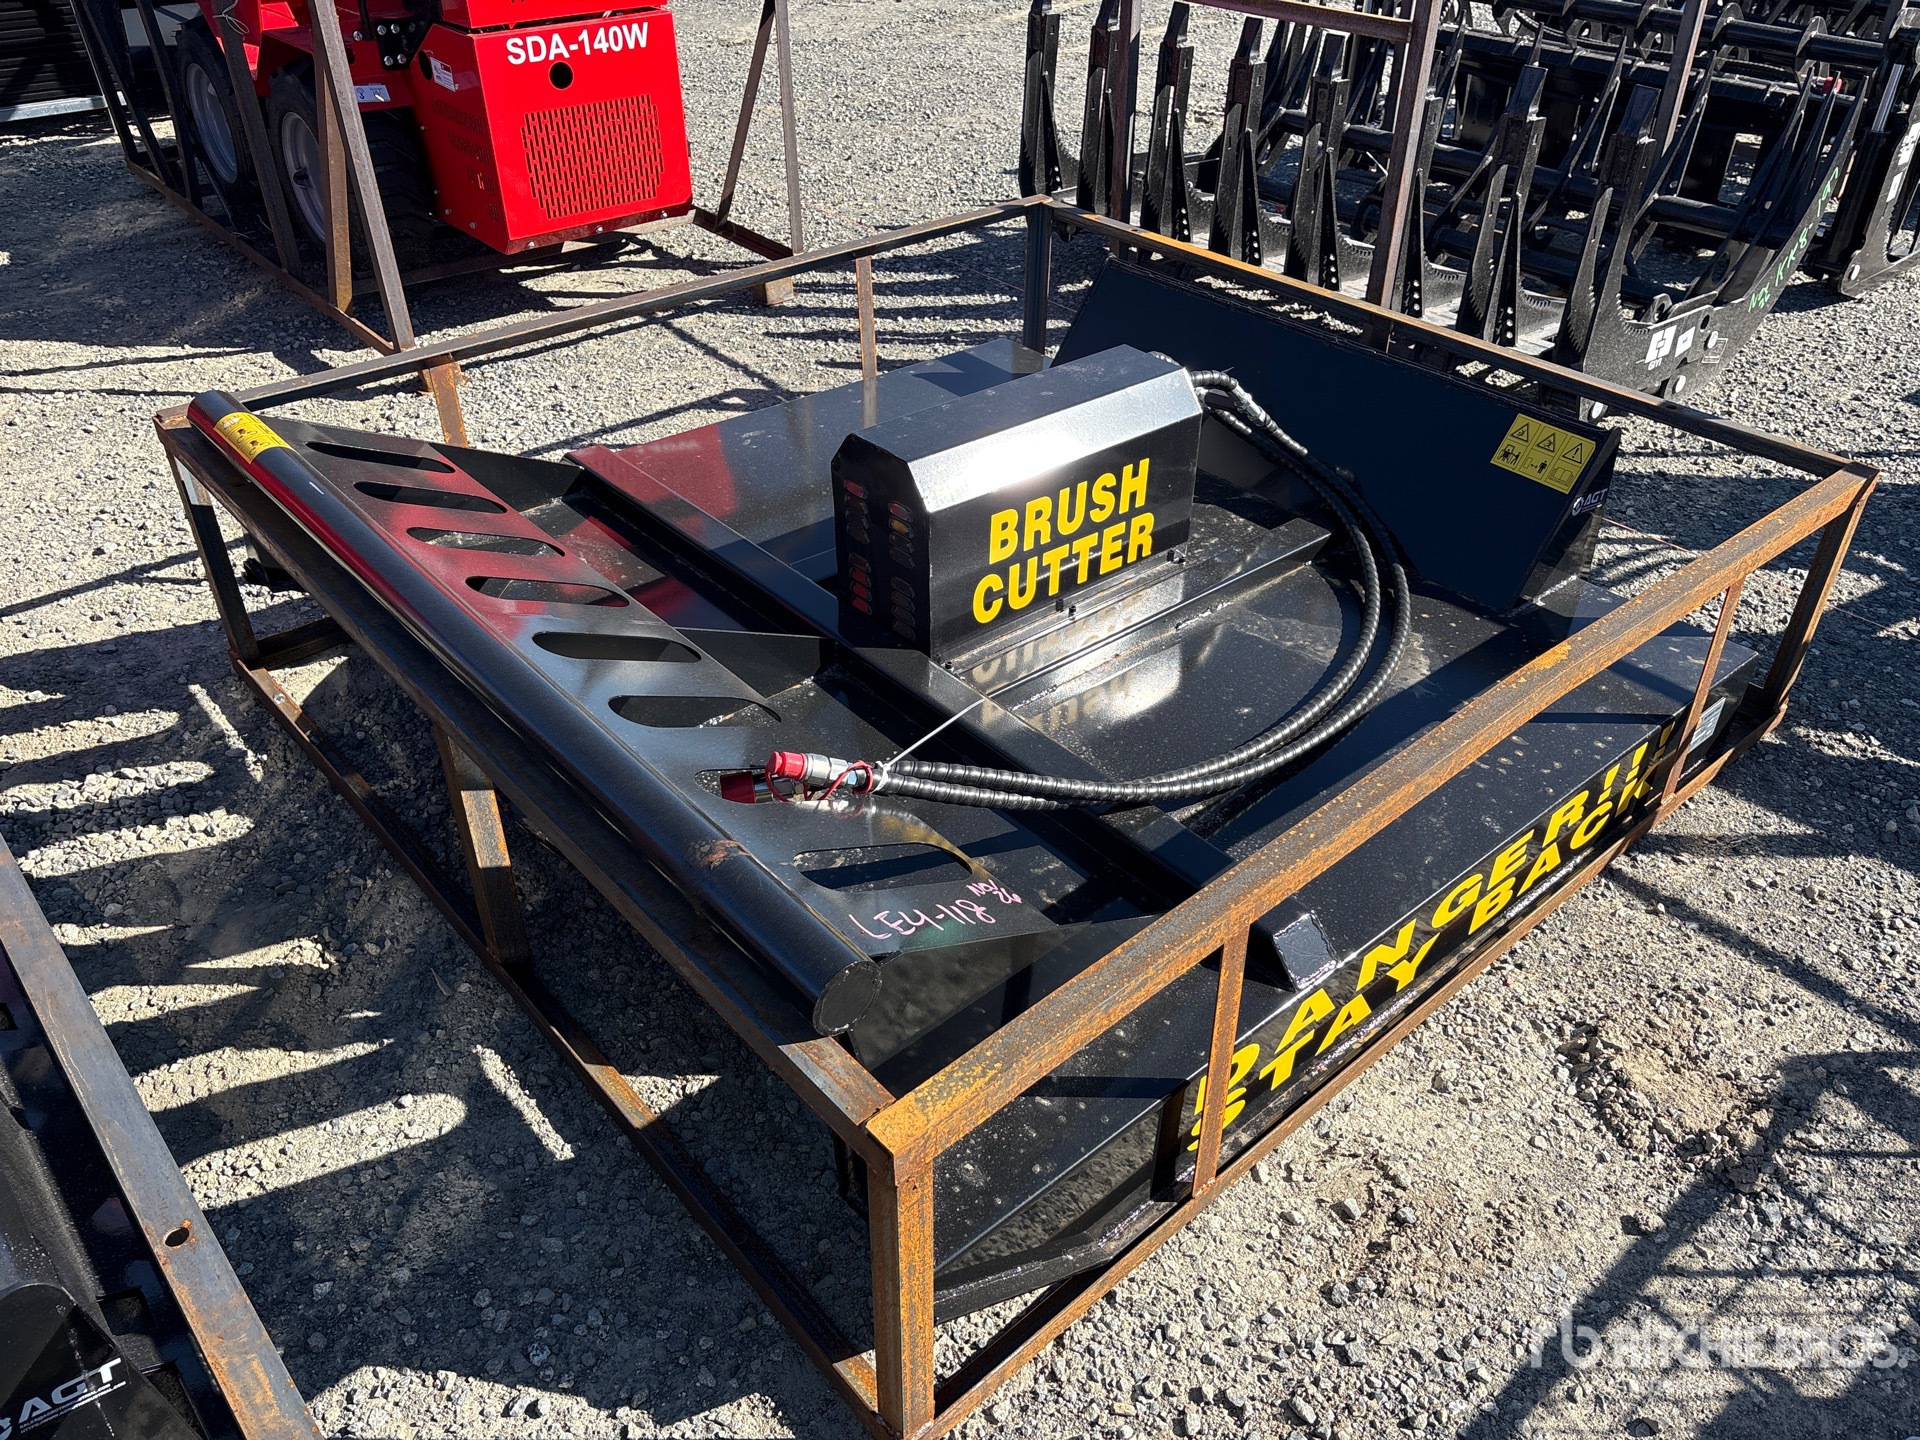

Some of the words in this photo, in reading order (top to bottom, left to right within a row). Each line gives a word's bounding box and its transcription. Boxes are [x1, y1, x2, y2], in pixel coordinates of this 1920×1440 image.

[506, 22, 648, 65] SDA-140W
[988, 457, 1150, 565] BRUSH
[972, 512, 1155, 624] CUTTER
[1467, 758, 1661, 937] BACK
[18, 1357, 122, 1424] AGT
